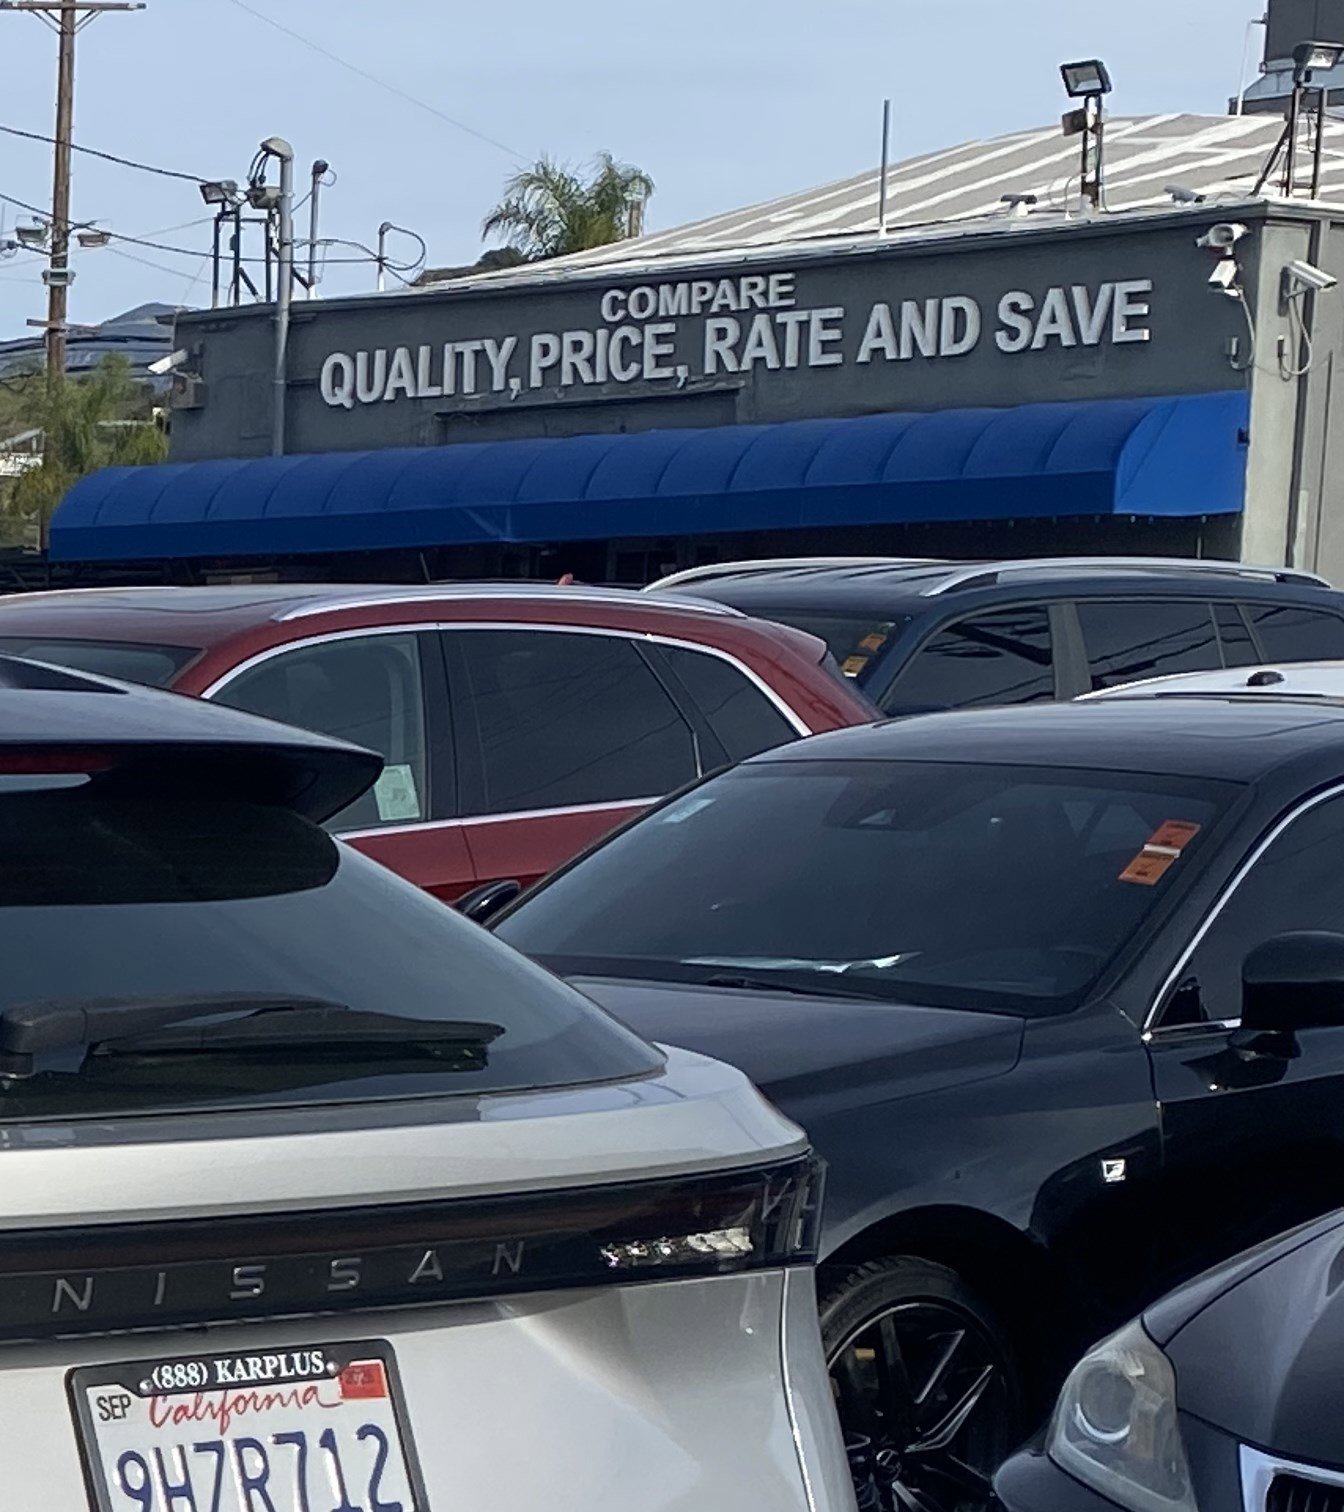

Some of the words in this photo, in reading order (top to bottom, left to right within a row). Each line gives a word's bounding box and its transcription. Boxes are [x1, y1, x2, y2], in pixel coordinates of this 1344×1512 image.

[600, 272, 797, 323] COMPARE
[319, 335, 520, 408] QUALITY,
[529, 322, 692, 390] PRICE,
[705, 306, 845, 376] RATE
[858, 287, 982, 362] AND
[995, 279, 1154, 354] SAVE
[51, 1240, 526, 1313] NISSAN
[151, 1366, 209, 1389] (888)
[213, 1350, 325, 1383] KARPLUS
[97, 1394, 132, 1422] SEP
[148, 1383, 343, 1435] California
